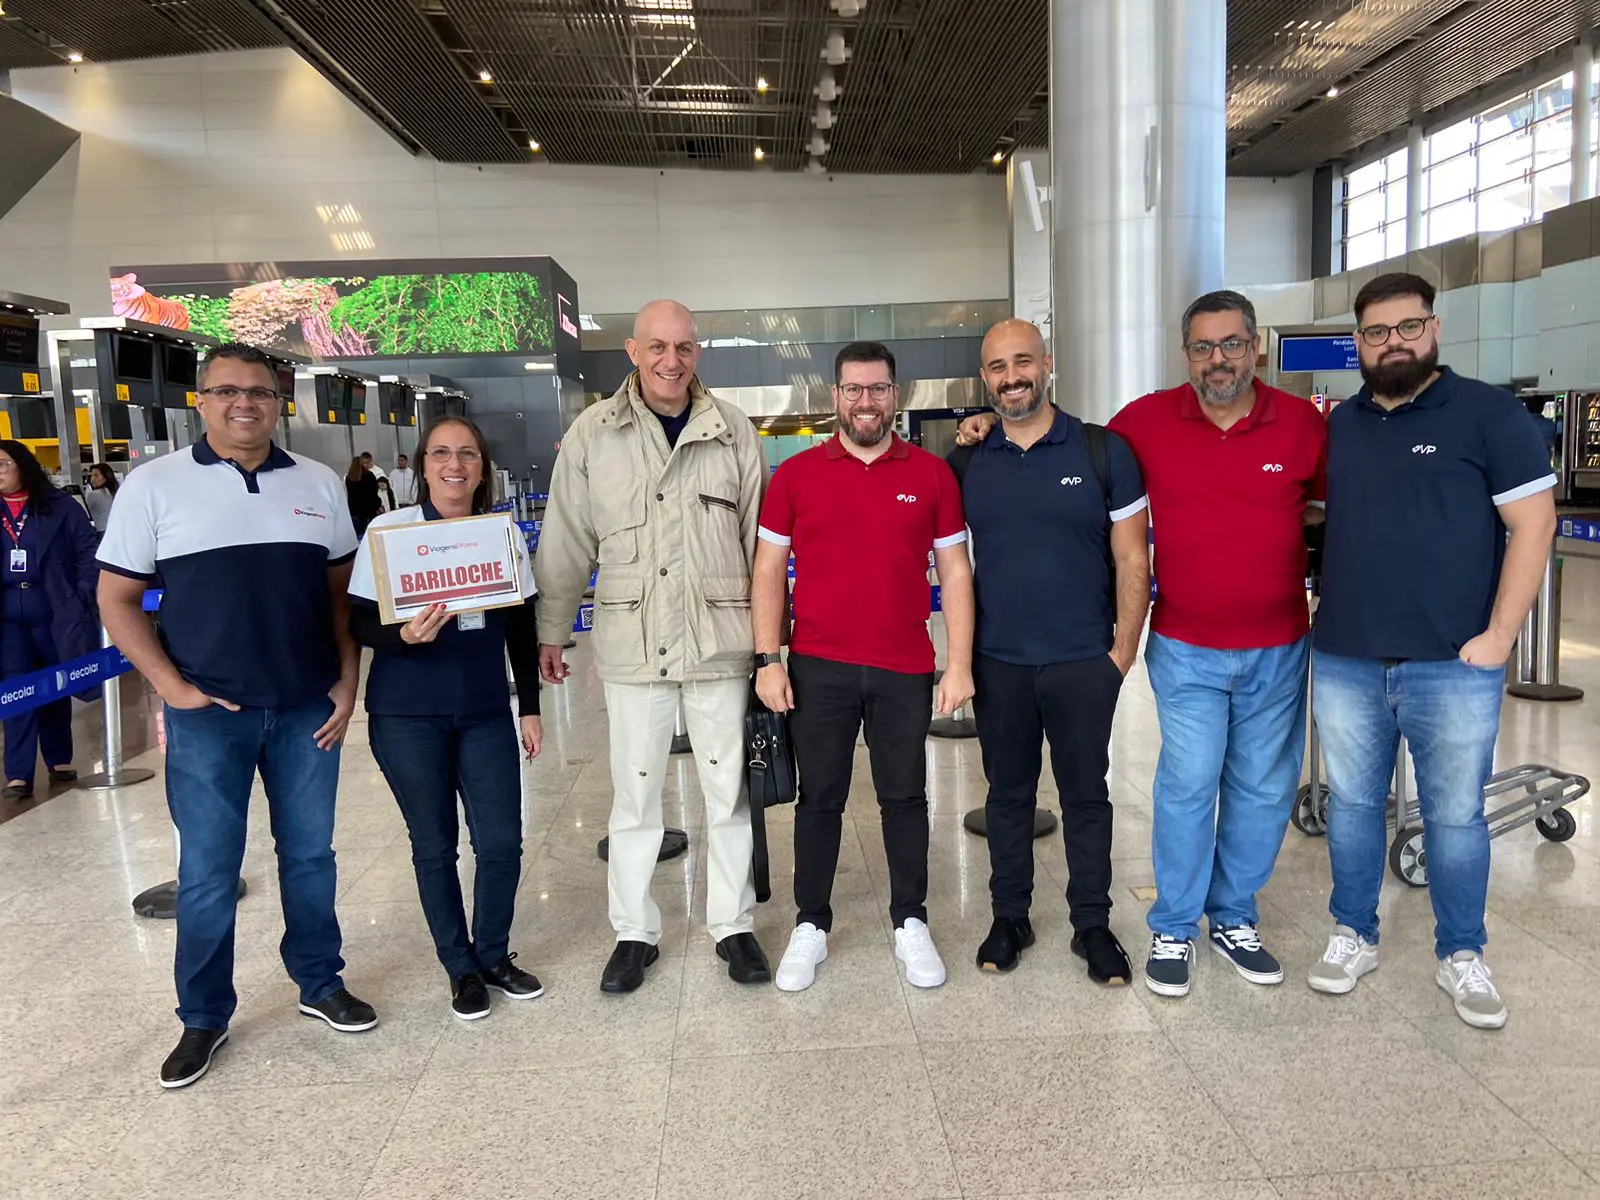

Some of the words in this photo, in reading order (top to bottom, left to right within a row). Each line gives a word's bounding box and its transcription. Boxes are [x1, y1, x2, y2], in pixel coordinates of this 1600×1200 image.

[400, 561, 505, 594] BARILOCHE
[69, 662, 100, 681] decolar
[0, 684, 36, 705] decolar
